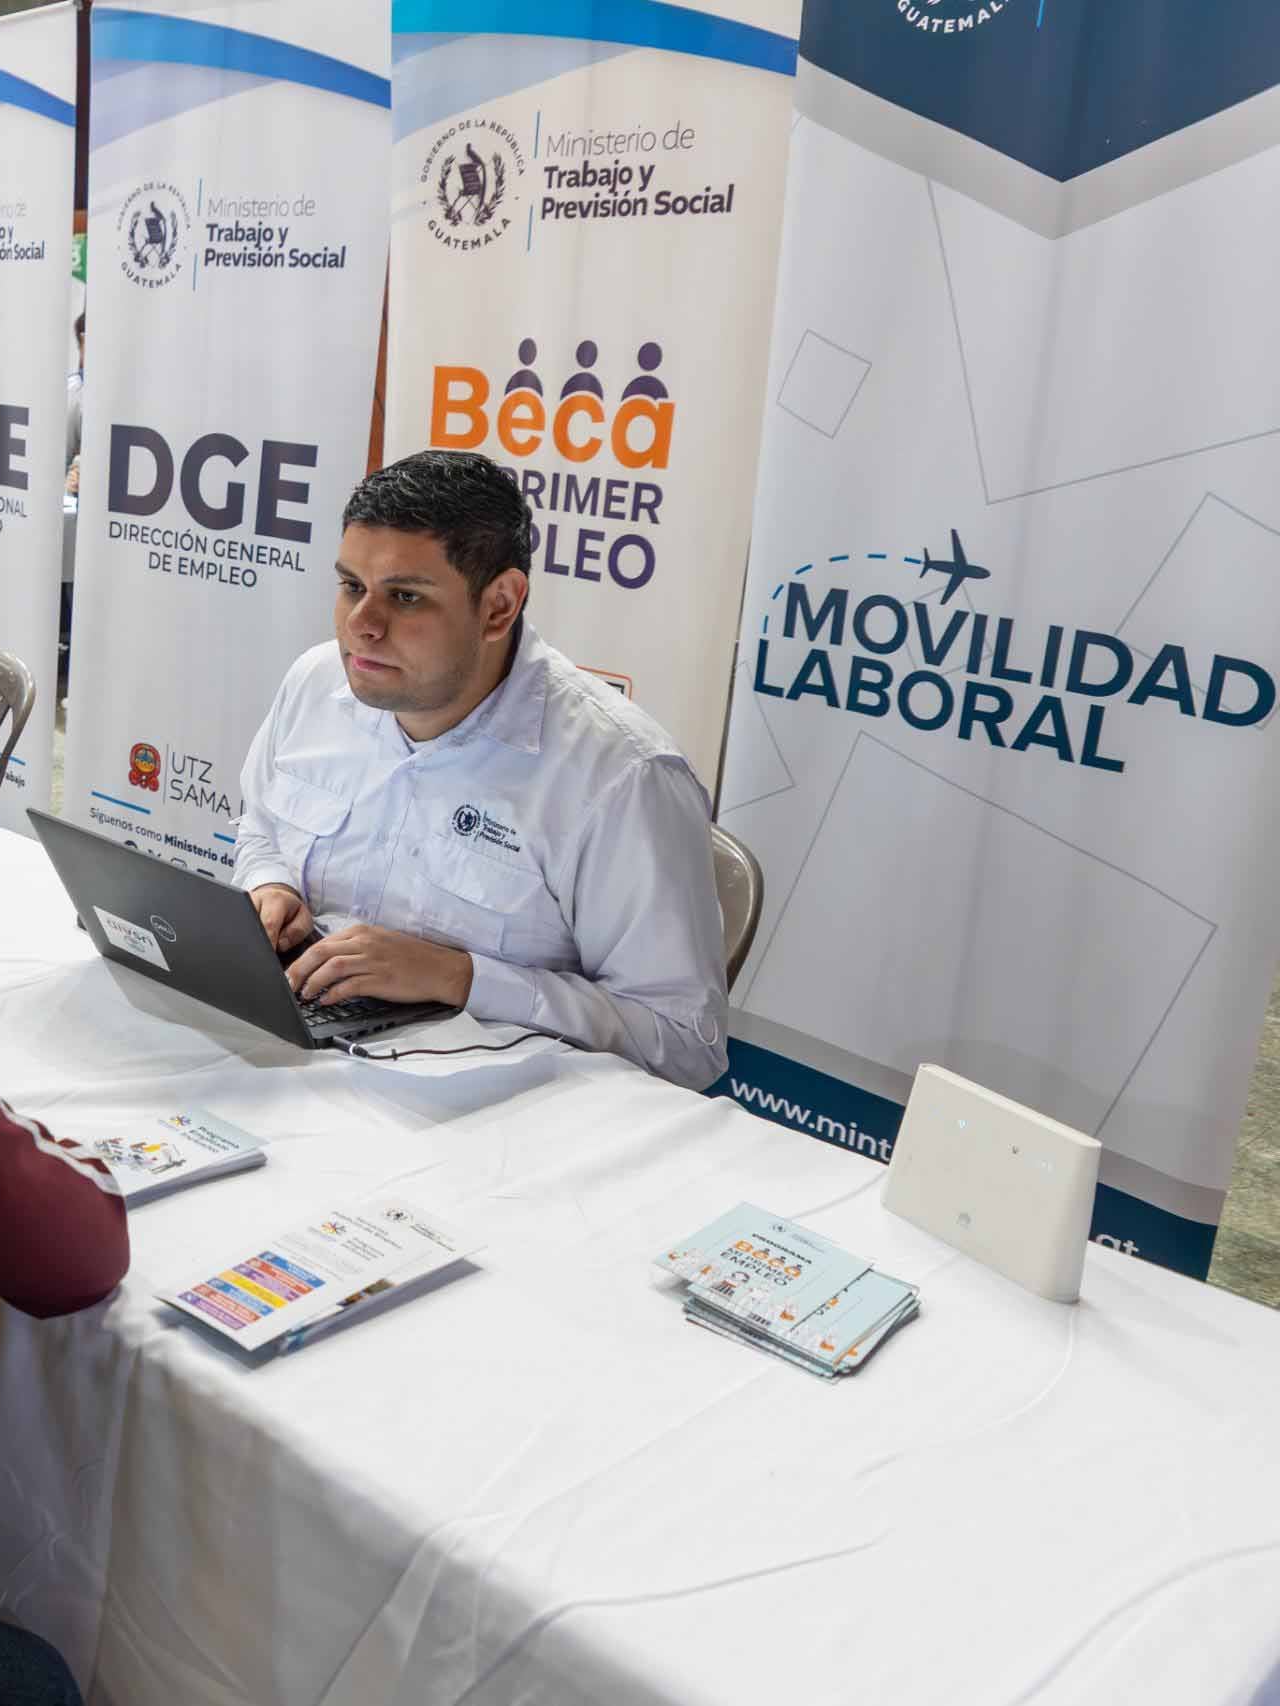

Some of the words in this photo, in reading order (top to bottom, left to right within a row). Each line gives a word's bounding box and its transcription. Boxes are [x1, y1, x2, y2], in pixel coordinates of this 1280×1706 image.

[897, 0, 1010, 33] GUATEMAL
[546, 125, 657, 159] Ministerio
[662, 119, 695, 151] de
[543, 160, 634, 194] Trabajo
[639, 163, 656, 192] y
[207, 196, 289, 218] Ministerio
[292, 194, 317, 217] de
[541, 190, 648, 220] Previsión
[653, 184, 735, 216] Social
[7, 224, 15, 244] y
[14, 240, 45, 261] Social
[205, 220, 274, 248] Trabajo
[278, 226, 289, 248] y
[427, 218, 511, 251] GUATEMALA
[203, 246, 285, 269] Previsión
[288, 245, 347, 269] Social
[429, 365, 676, 469] Beca
[108, 423, 319, 544] DGE
[108, 520, 208, 554] DIRECCIÓN
[213, 538, 306, 572] GENERAL
[530, 522, 656, 590] LEO
[148, 551, 172, 572] DE
[177, 556, 258, 588] EMPLEO
[782, 581, 1278, 728] MOVILIDAD
[753, 638, 1126, 773] LABORAL
[171, 751, 213, 784] UTZ
[135, 824, 163, 842] como
[164, 833, 218, 862] Ministerio
[220, 853, 236, 868] de
[730, 1077, 893, 1162] www.mint
